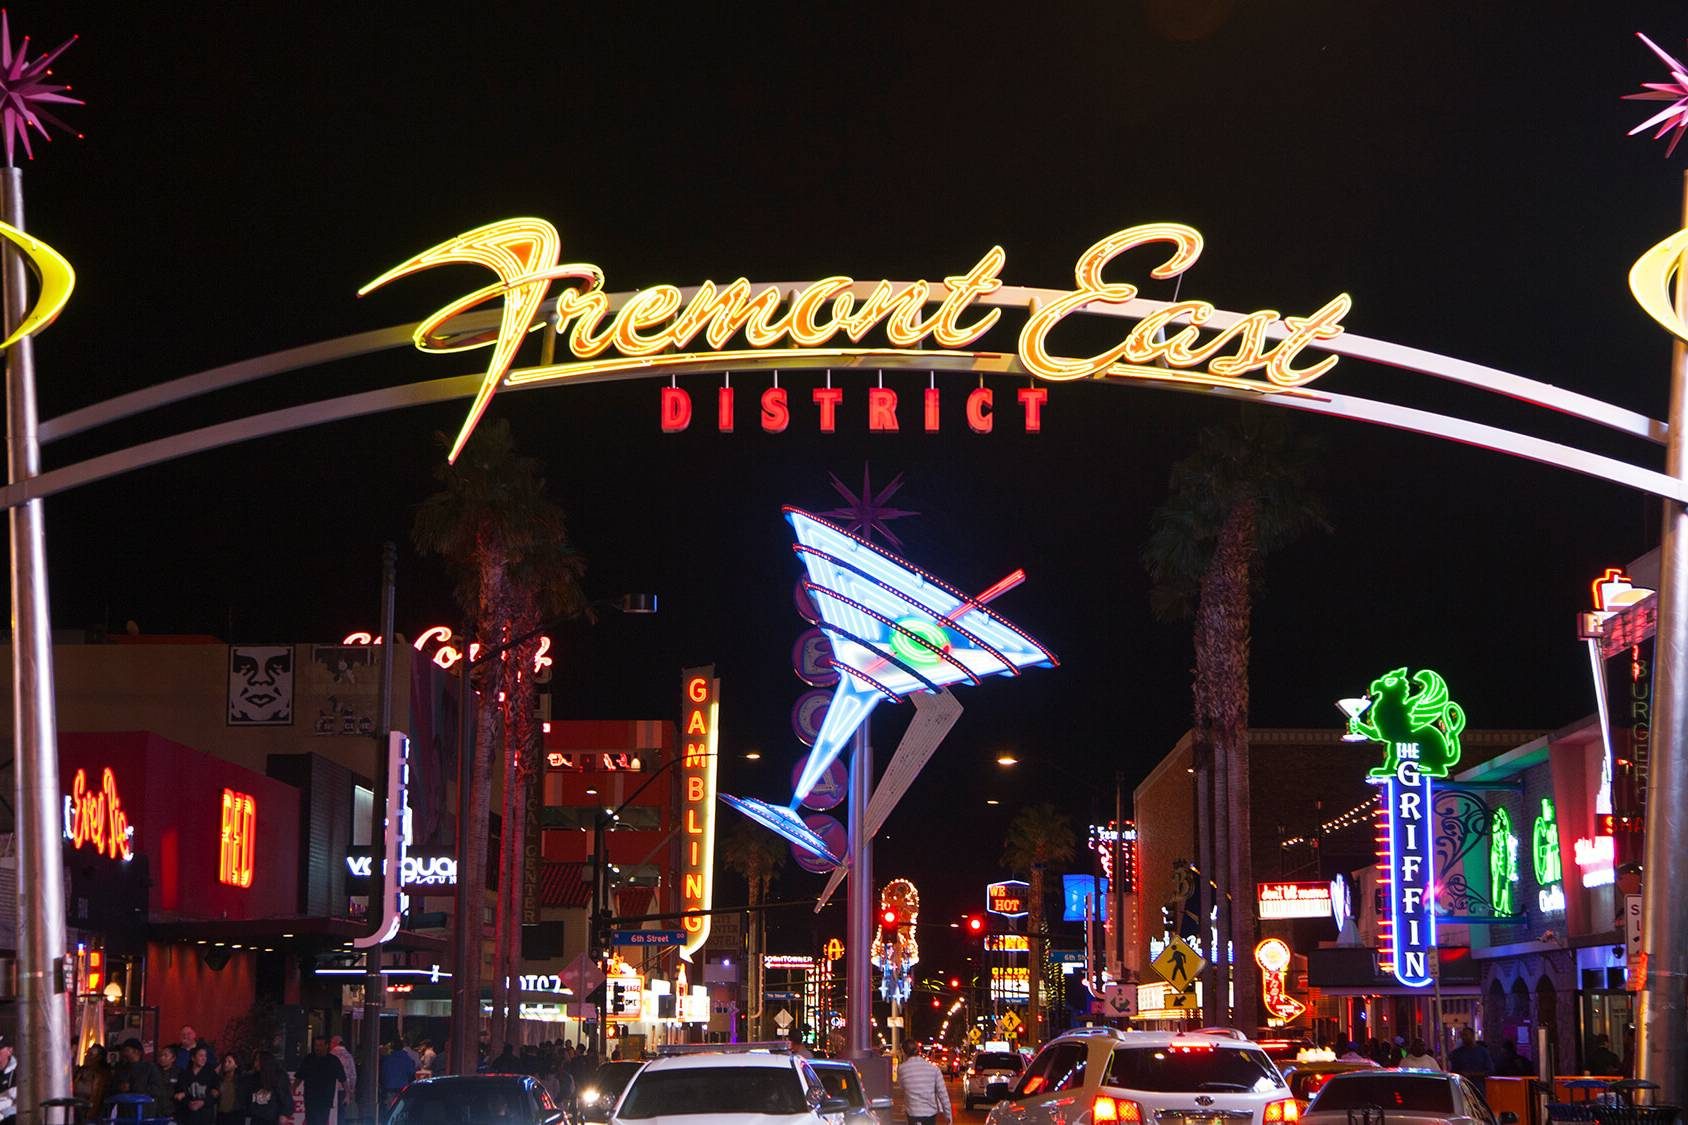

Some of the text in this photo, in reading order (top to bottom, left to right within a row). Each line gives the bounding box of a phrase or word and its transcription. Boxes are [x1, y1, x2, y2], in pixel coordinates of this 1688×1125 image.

[357, 216, 1353, 464] Fremont East
[660, 386, 1049, 433] DISTRICT
[683, 678, 708, 932] GAMBLING
[1396, 742, 1420, 760] THE
[1397, 763, 1426, 978] GRIFFIN
[631, 934, 645, 943] 6th
[646, 934, 670, 943] Street
